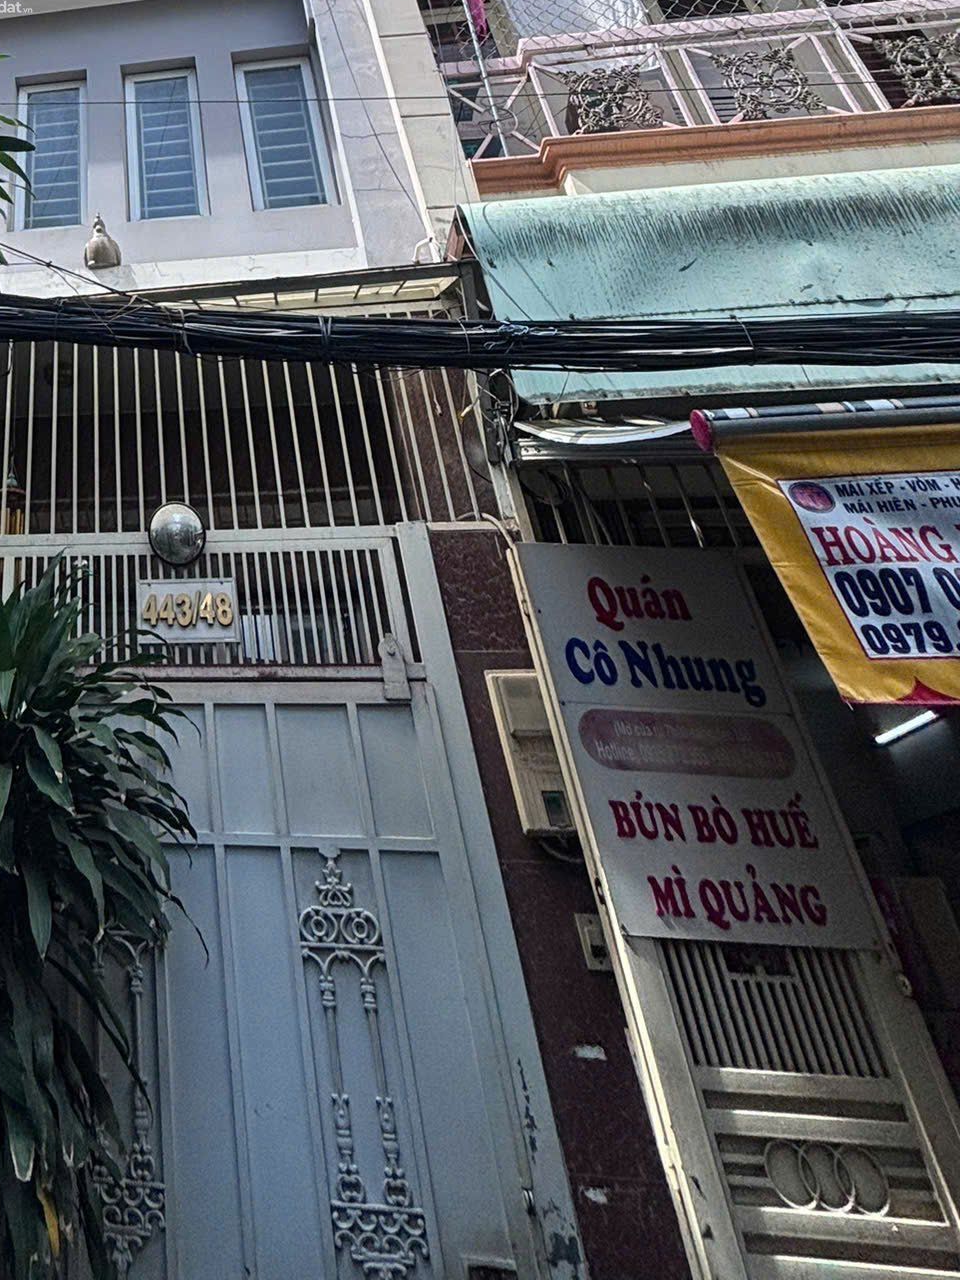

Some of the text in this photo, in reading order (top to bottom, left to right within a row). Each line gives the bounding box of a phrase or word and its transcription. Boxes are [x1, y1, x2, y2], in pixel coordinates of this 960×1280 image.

[835, 483, 865, 498] MÁI
[867, 477, 895, 496] XẾP
[907, 476, 943, 493] VÒM
[844, 499, 874, 514] MÁI
[876, 494, 917, 513] HIÊN
[810, 517, 959, 566] HOÀNG
[142, 591, 234, 627] 443/48
[587, 575, 693, 631] Quán
[834, 567, 960, 617] 0907 0
[565, 637, 766, 708] Cô Nhung
[608, 790, 819, 848] BÚN BÒ HUẾ
[647, 863, 827, 930] MÌ QUẢNG
